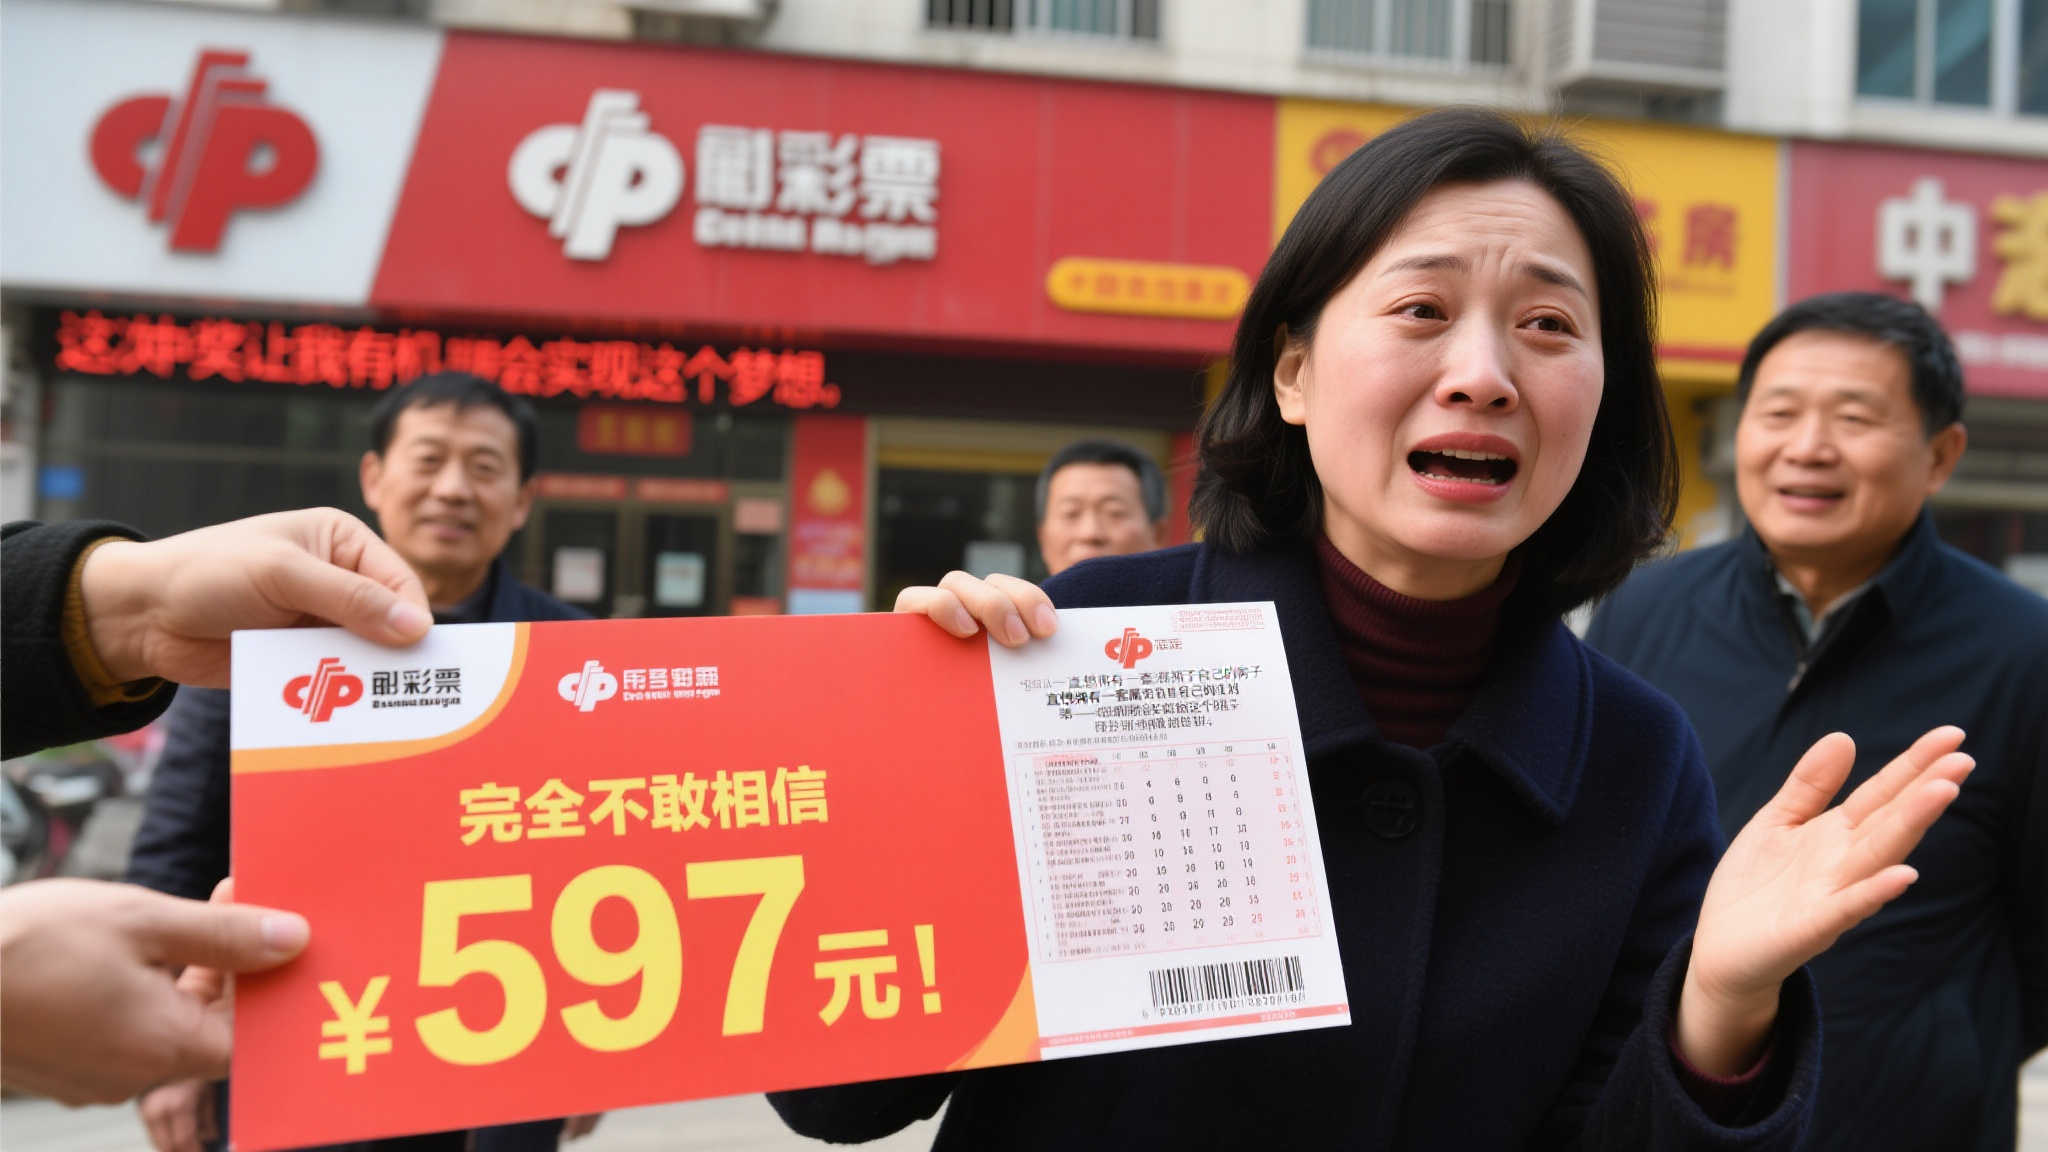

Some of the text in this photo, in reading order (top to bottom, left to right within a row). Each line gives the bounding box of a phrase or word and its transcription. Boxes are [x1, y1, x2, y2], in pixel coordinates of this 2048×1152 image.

[459, 765, 830, 846] 完全不敢相信
